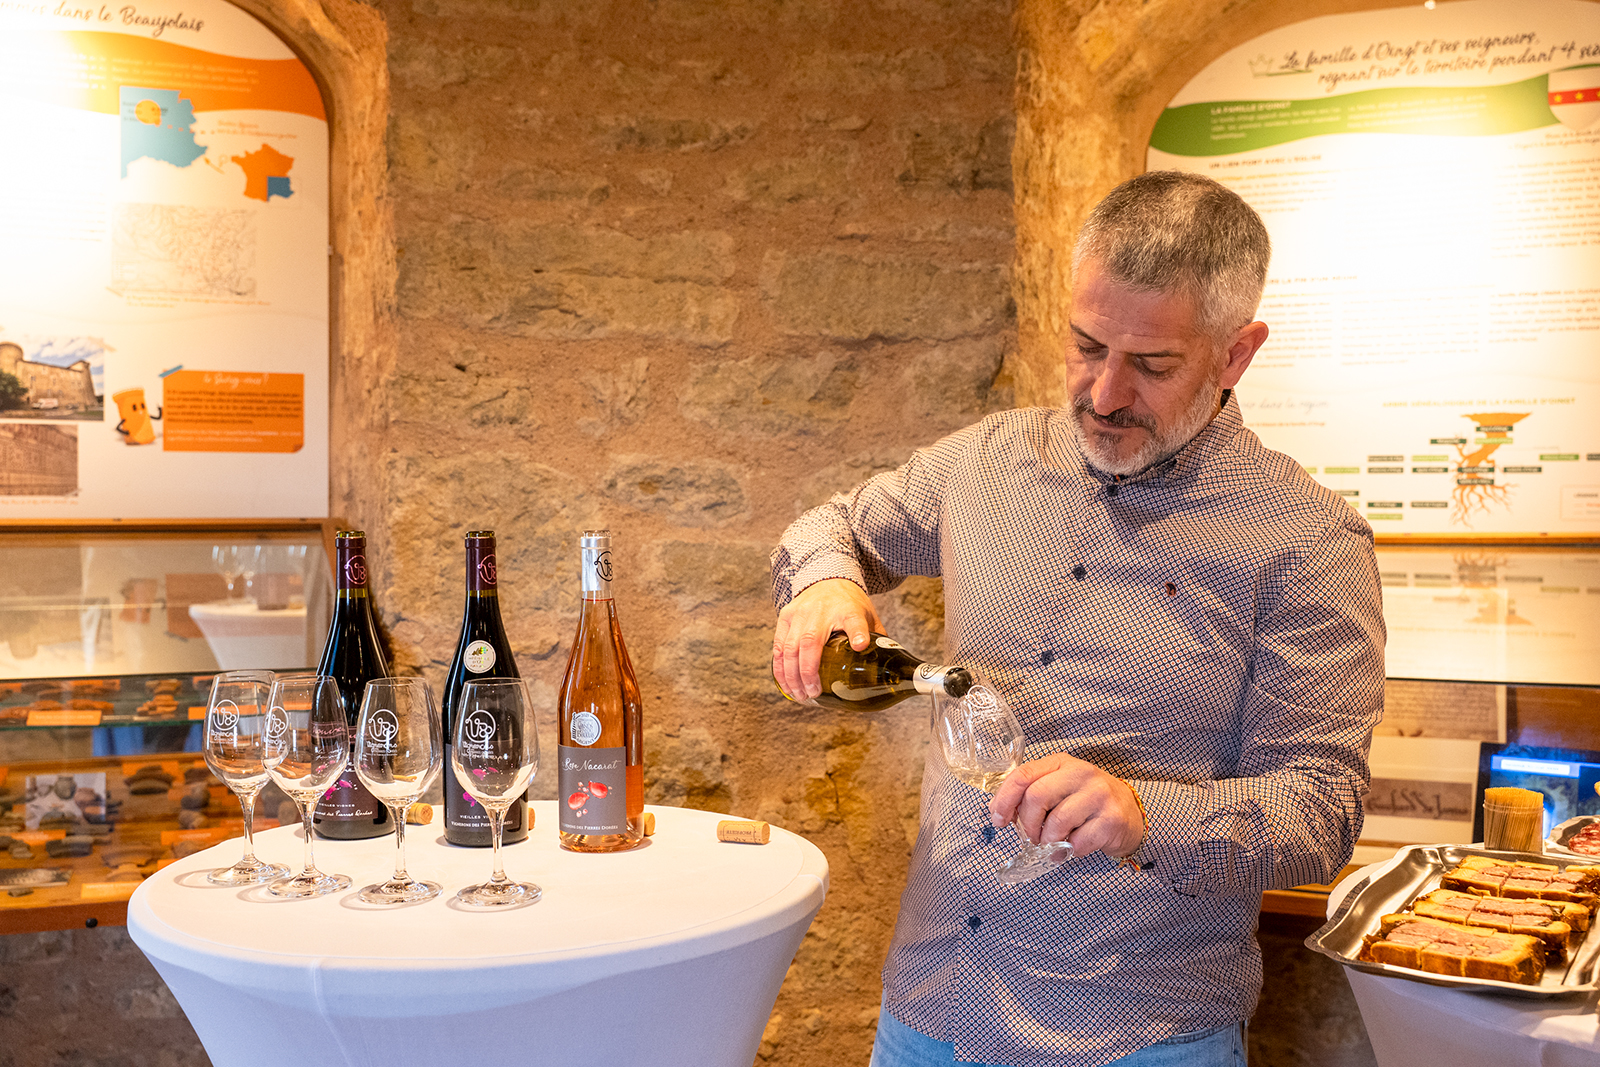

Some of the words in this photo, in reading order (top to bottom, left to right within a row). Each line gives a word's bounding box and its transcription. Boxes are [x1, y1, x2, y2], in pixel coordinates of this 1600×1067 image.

[53, 1, 95, 21] dans
[97, 5, 114, 22] le
[119, 5, 204, 38] Beaujolais
[1279, 51, 1301, 69] La
[1305, 46, 1357, 71] famille
[1361, 40, 1423, 66] d'Oingt
[1423, 39, 1439, 54] et
[1440, 40, 1461, 53] ses
[1378, 66, 1401, 80] sur
[1405, 59, 1420, 75] le
[1423, 55, 1487, 75] territoire
[1488, 47, 1558, 74] pendant
[1560, 41, 1576, 59] 4
[1579, 43, 1600, 59] siè
[1211, 106, 1221, 115] LA
[1223, 103, 1256, 113] FAMILLE
[1257, 101, 1291, 111] D'OINGT
[1209, 161, 1220, 170] UN
[1383, 400, 1408, 408] ARBRE
[1502, 397, 1538, 405] FAMILLE
[1540, 396, 1576, 405] D'OINGT
[462, 740, 494, 752] Vigneros
[576, 759, 622, 772] Nacarat
